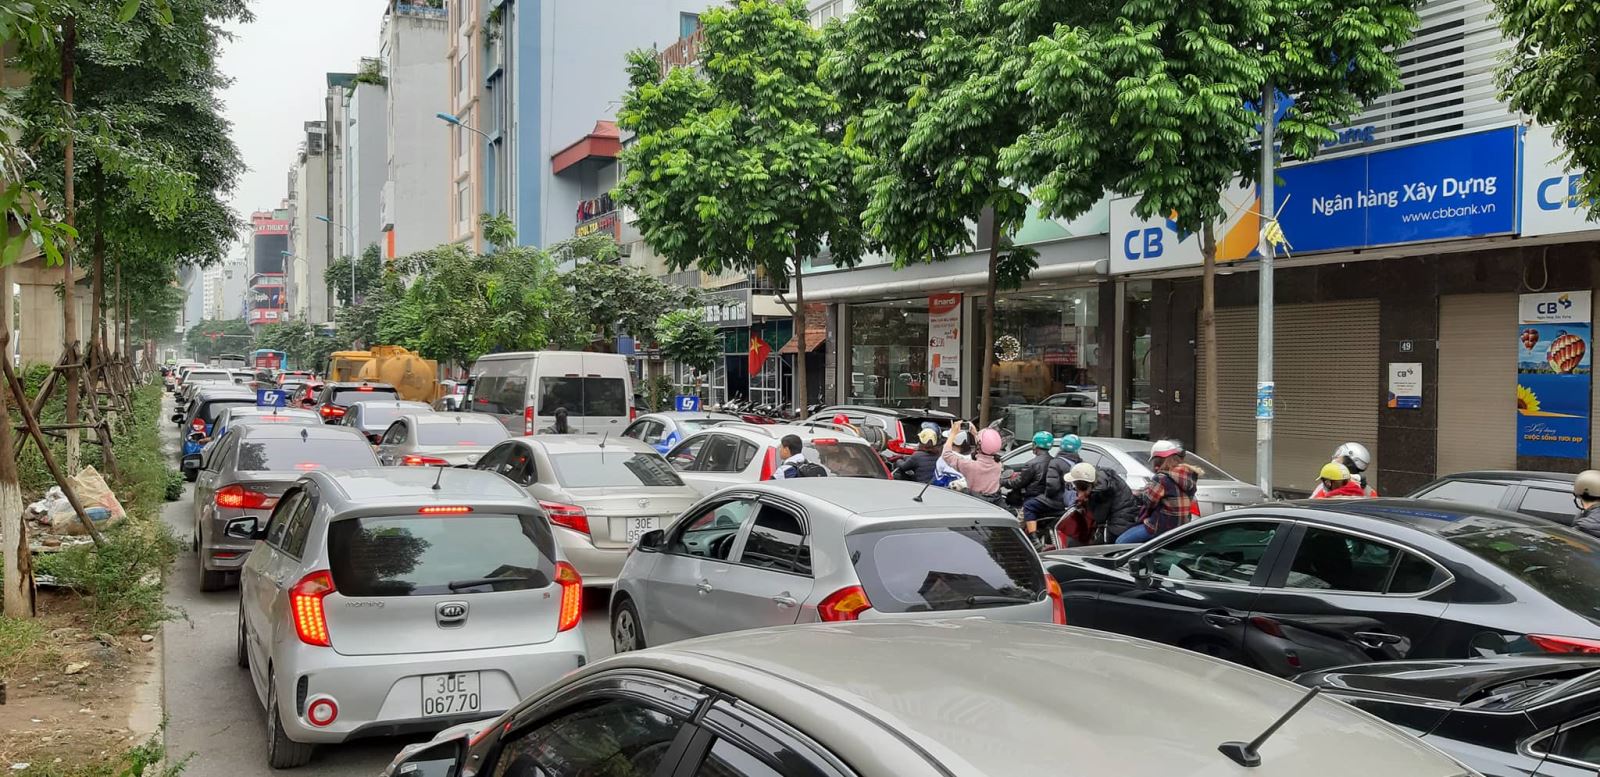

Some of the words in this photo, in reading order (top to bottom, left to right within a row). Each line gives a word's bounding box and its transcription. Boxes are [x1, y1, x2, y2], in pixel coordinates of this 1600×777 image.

[1312, 194, 1353, 216] Ngân
[1357, 189, 1399, 208] hàng
[1402, 182, 1438, 203] Xây
[1442, 176, 1497, 199] Dựng
[1402, 203, 1496, 223] www.cbbank.vn
[1124, 227, 1163, 260] CB
[1537, 302, 1557, 314] CB
[1401, 342, 1411, 351] 49
[1397, 370, 1407, 378] CB
[635, 518, 652, 529] 30E
[444, 607, 462, 616] KIA
[436, 674, 467, 694] 30E
[425, 693, 478, 714] 067.70
